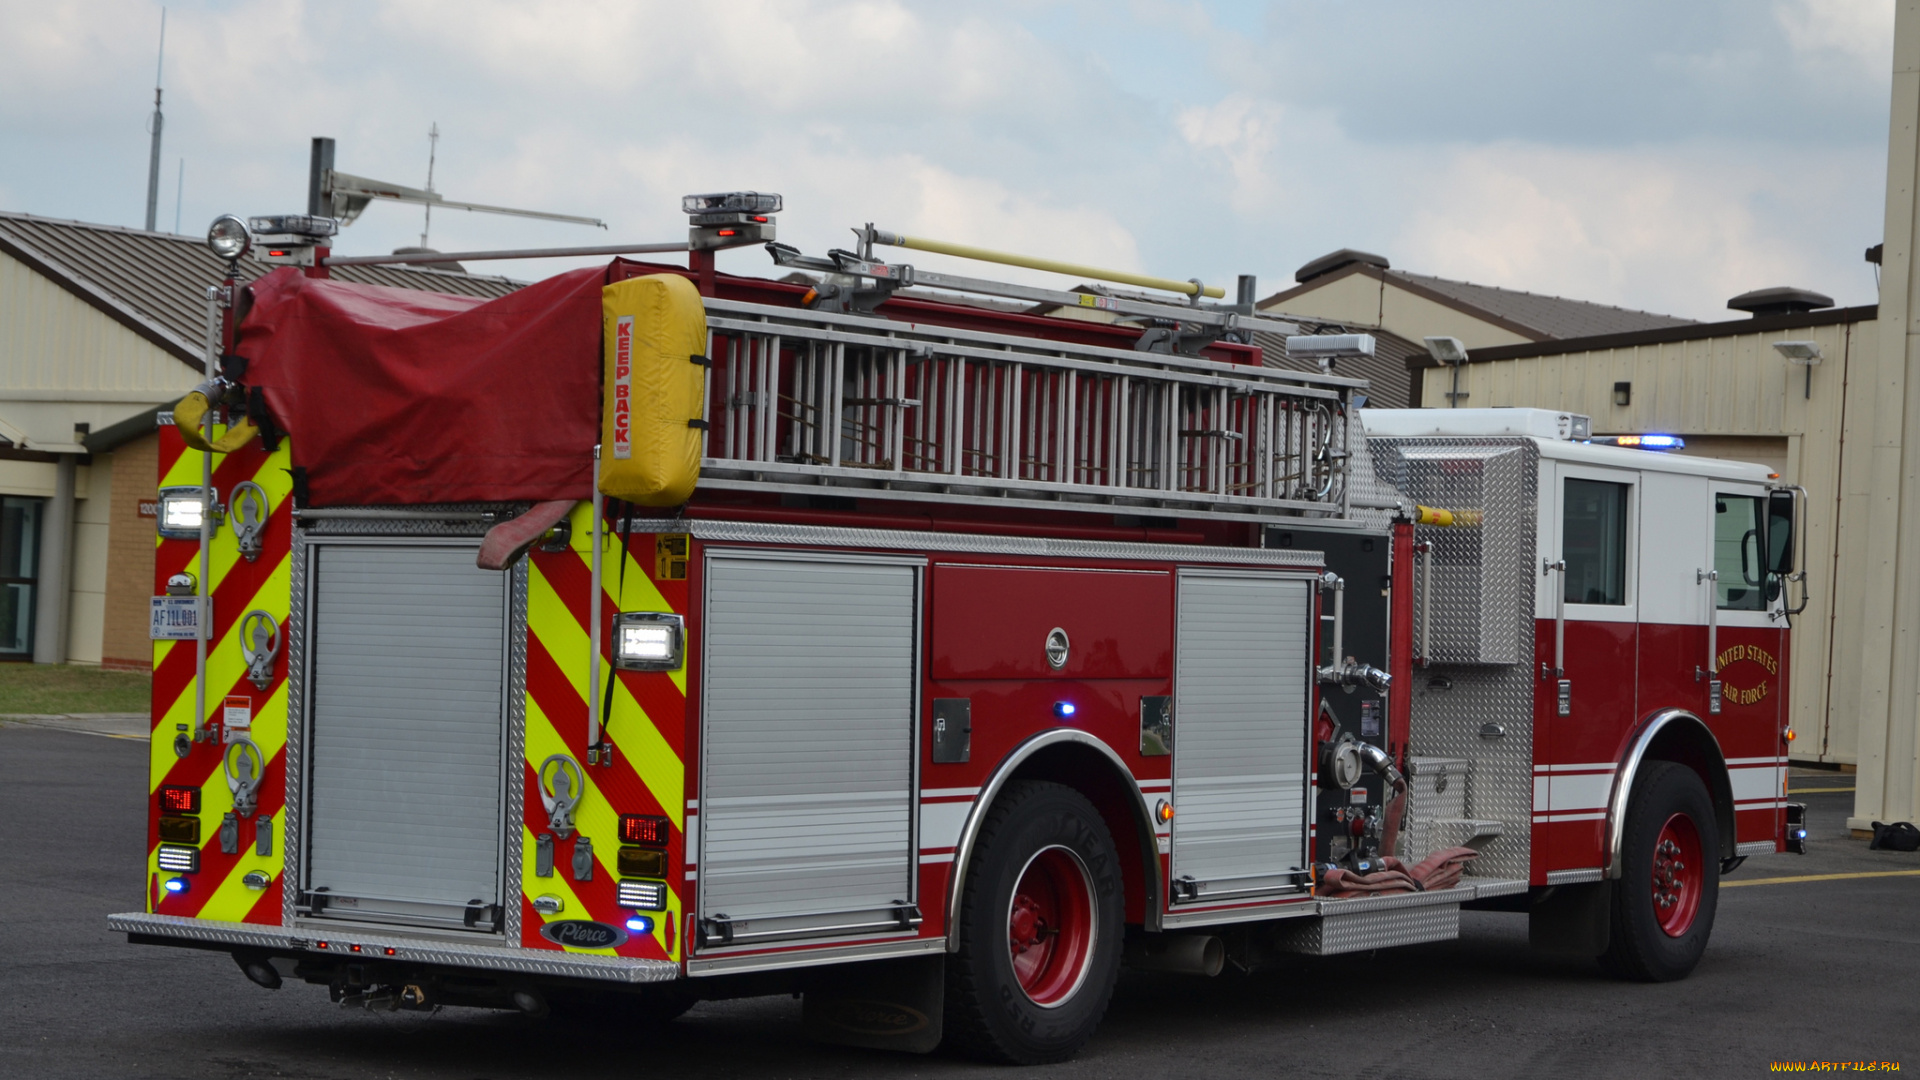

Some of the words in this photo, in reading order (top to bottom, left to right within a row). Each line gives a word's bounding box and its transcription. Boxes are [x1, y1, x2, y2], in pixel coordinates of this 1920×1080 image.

[616, 322, 631, 380] KEEP
[615, 384, 630, 443] BACK
[1747, 645, 1777, 675] STATES
[1722, 682, 1738, 703] AIR
[1740, 680, 1768, 705] FORCE
[560, 922, 608, 942] Pierce
